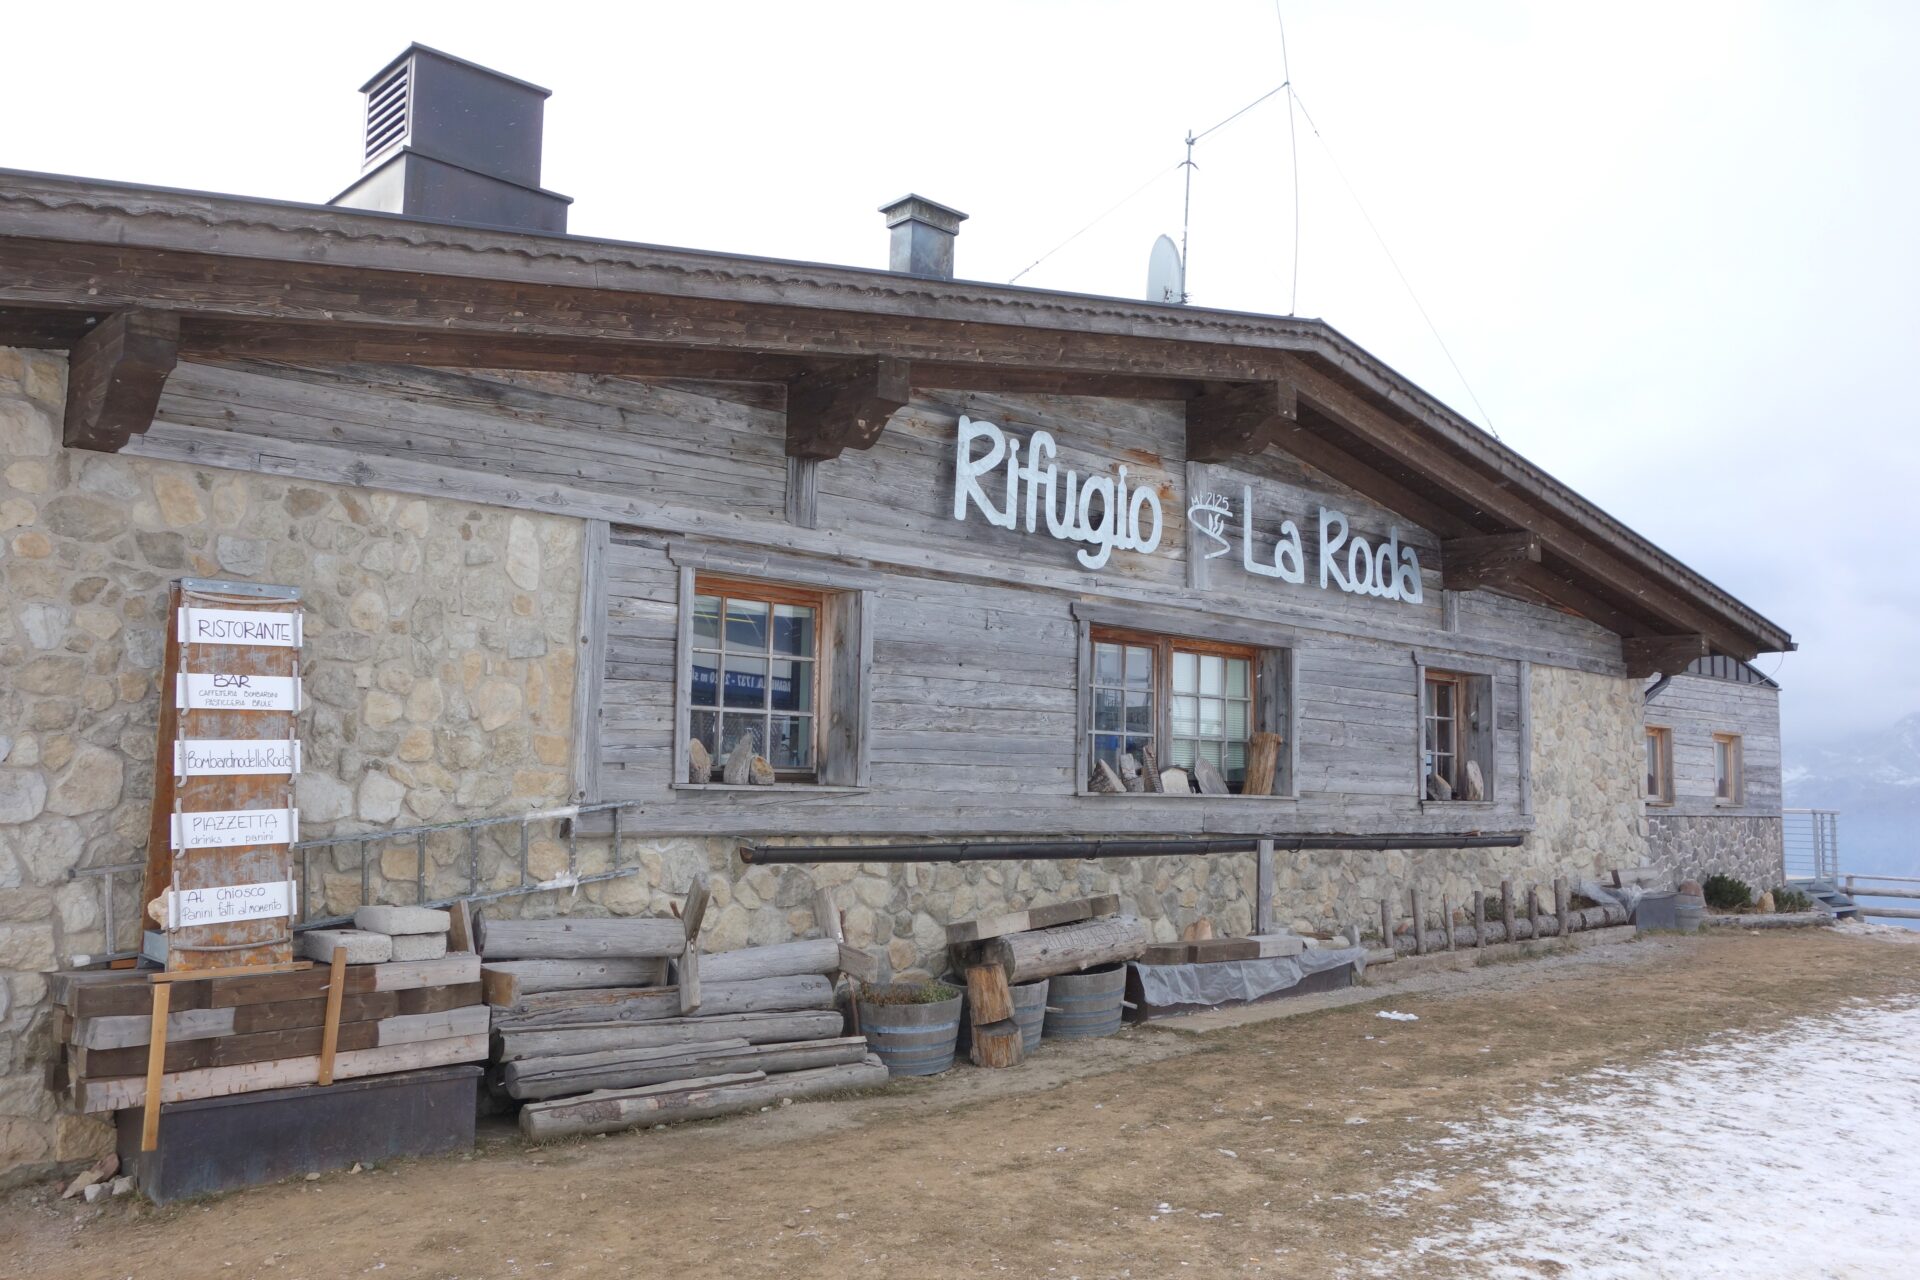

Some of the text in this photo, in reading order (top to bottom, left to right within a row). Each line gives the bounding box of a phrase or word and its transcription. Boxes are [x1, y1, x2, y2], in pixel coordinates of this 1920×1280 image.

[954, 414, 1424, 604] Rifugio La Roda
[1205, 492, 1229, 511] 2125
[197, 619, 291, 641] RISTORANTE
[213, 674, 251, 688] BAR
[192, 813, 279, 832] PIAZZETTA
[190, 834, 222, 845] drinks
[245, 831, 274, 844] panini
[181, 898, 282, 920] Panini fatti al momento
